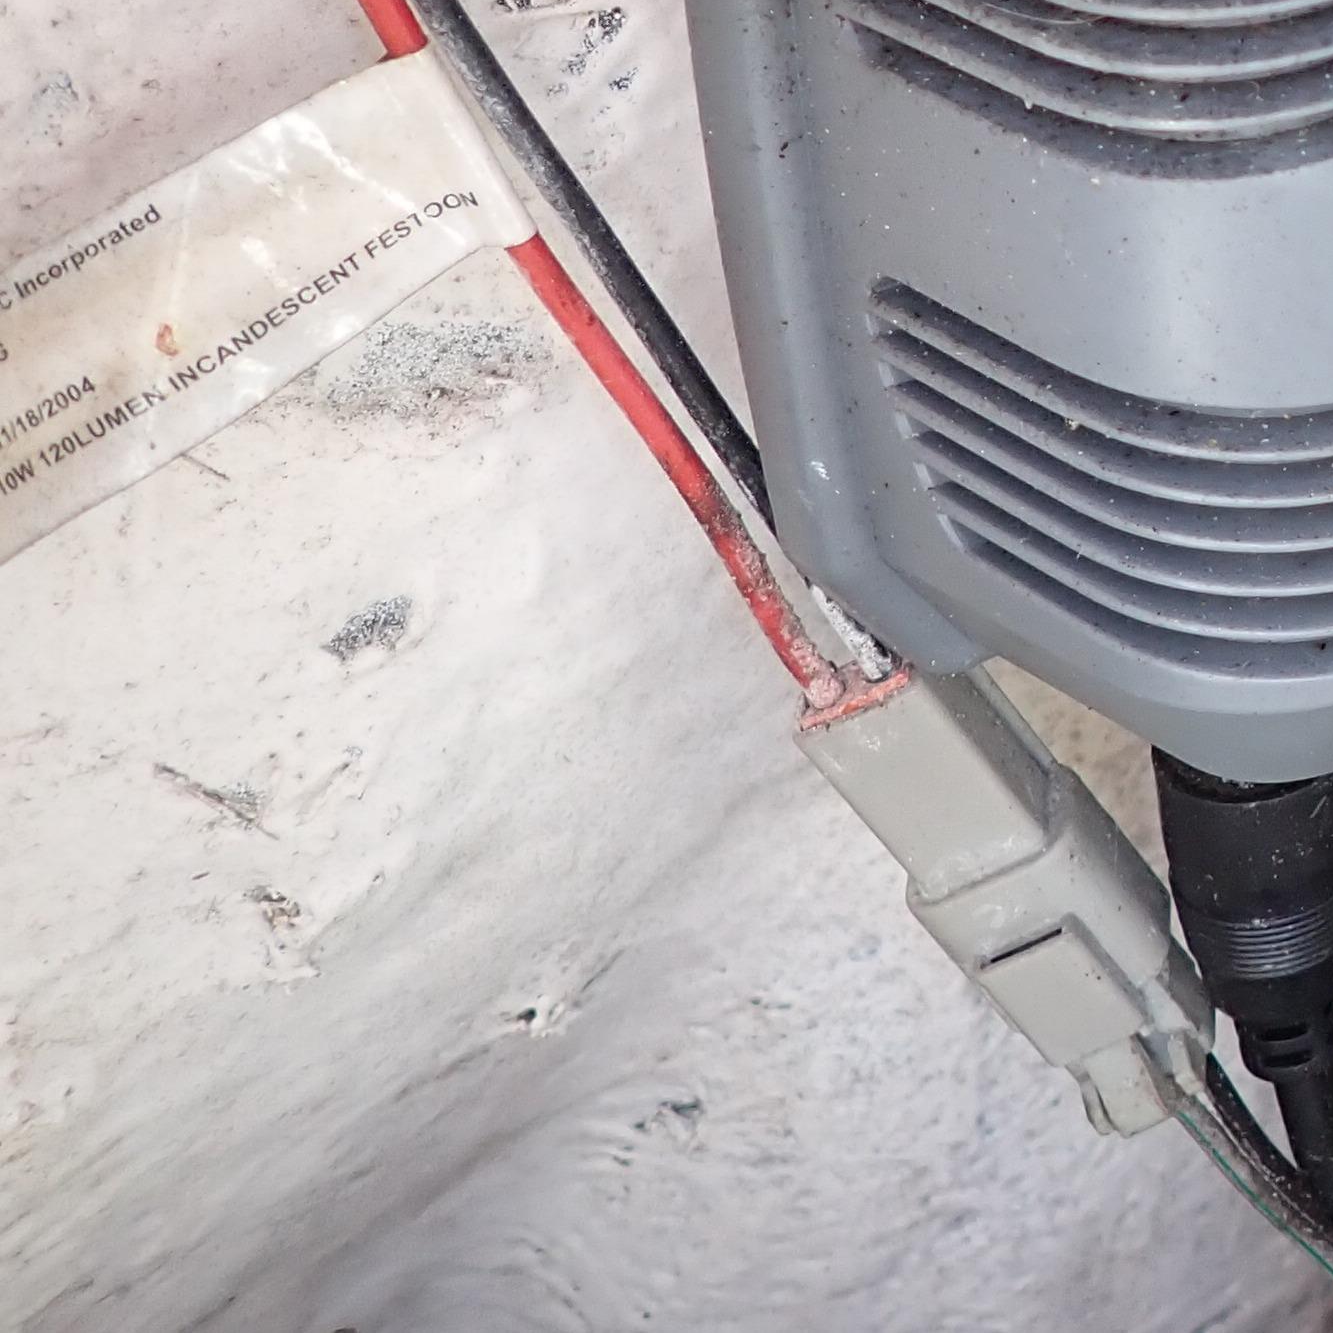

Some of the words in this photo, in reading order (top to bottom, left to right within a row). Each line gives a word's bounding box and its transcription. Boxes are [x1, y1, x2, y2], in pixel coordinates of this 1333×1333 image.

[14, 203, 164, 299] Incorporated
[39, 389, 167, 468] 120LUMEN
[167, 251, 362, 393] INCANDESCENT
[363, 190, 480, 260] FESTOON
[0, 375, 96, 449] 1/18/2004
